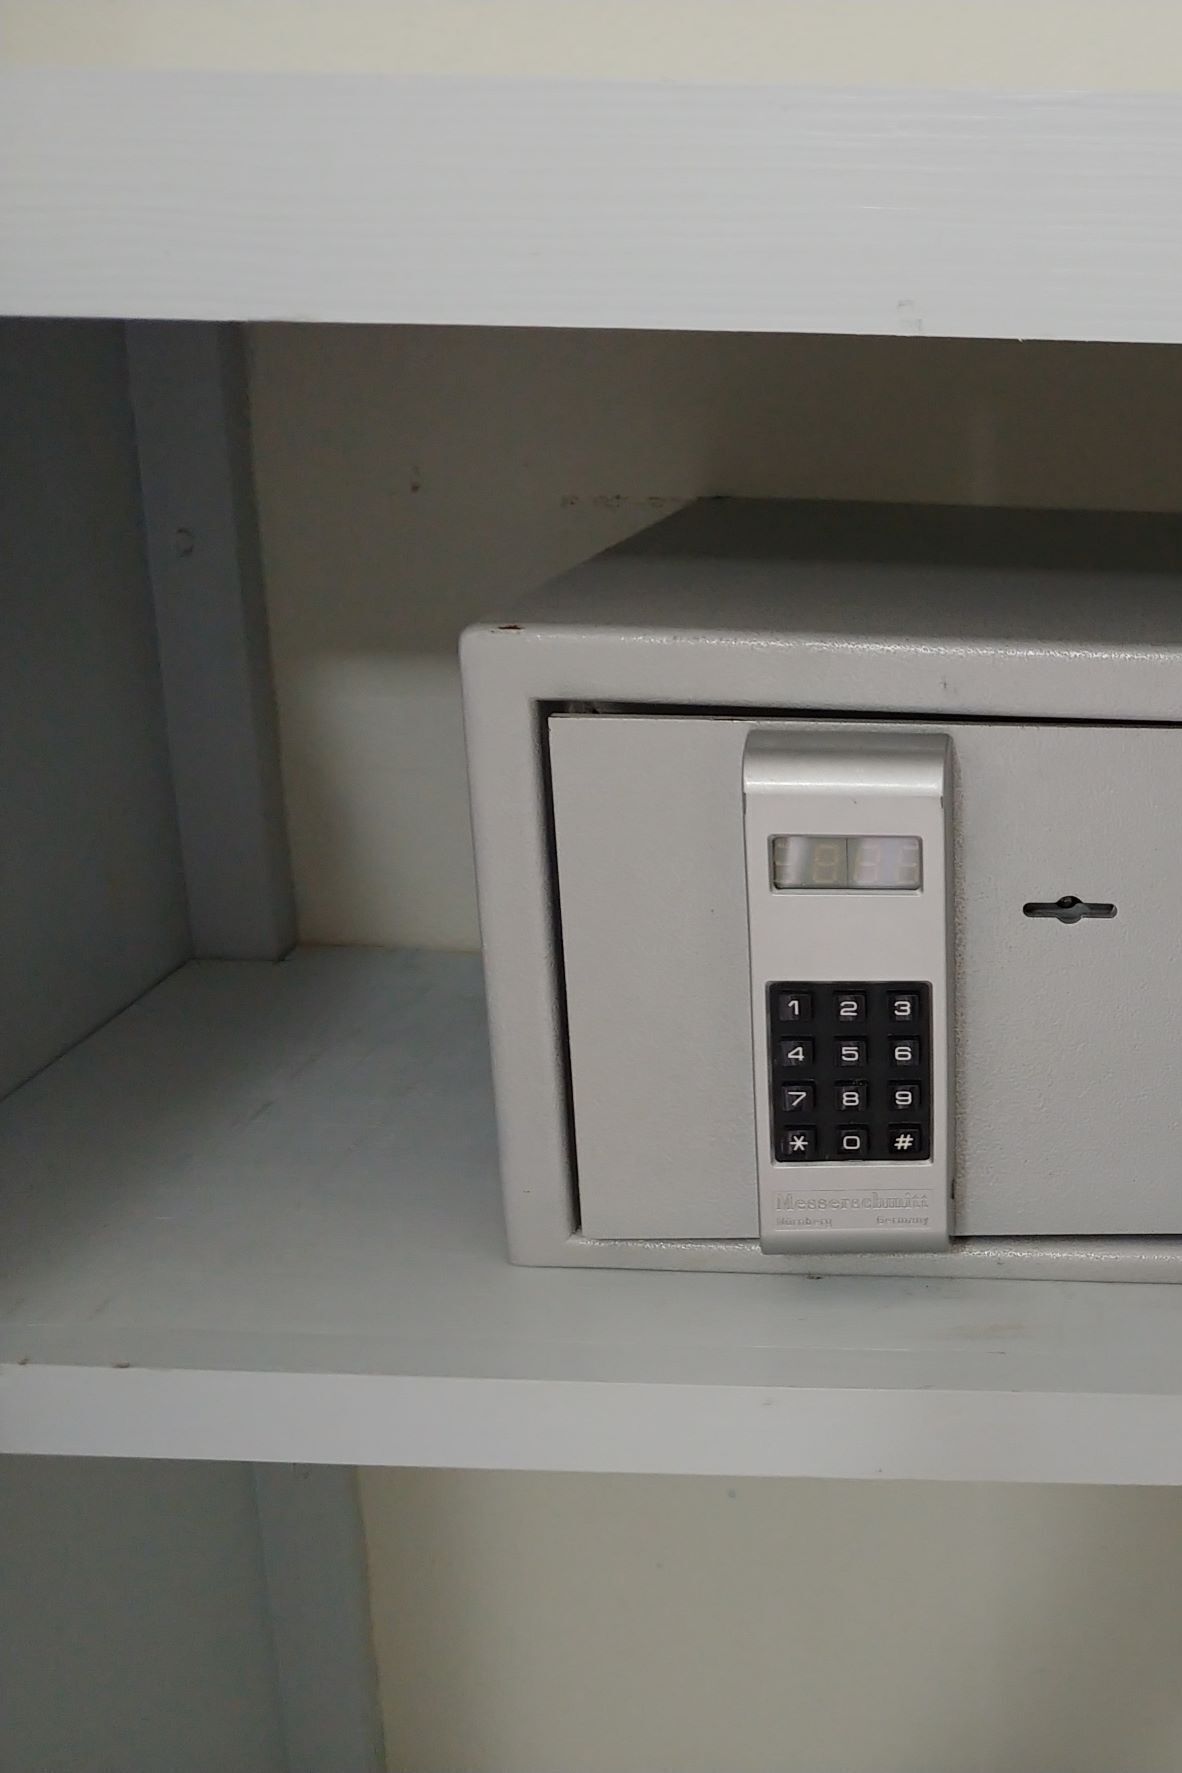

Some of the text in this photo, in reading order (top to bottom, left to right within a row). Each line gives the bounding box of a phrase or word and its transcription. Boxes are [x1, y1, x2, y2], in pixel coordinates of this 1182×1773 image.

[788, 1000, 911, 1016] 1 2 3
[787, 1046, 912, 1061] 4 5 6
[787, 1091, 912, 1106] 7 8 9
[894, 1134, 913, 1149] #
